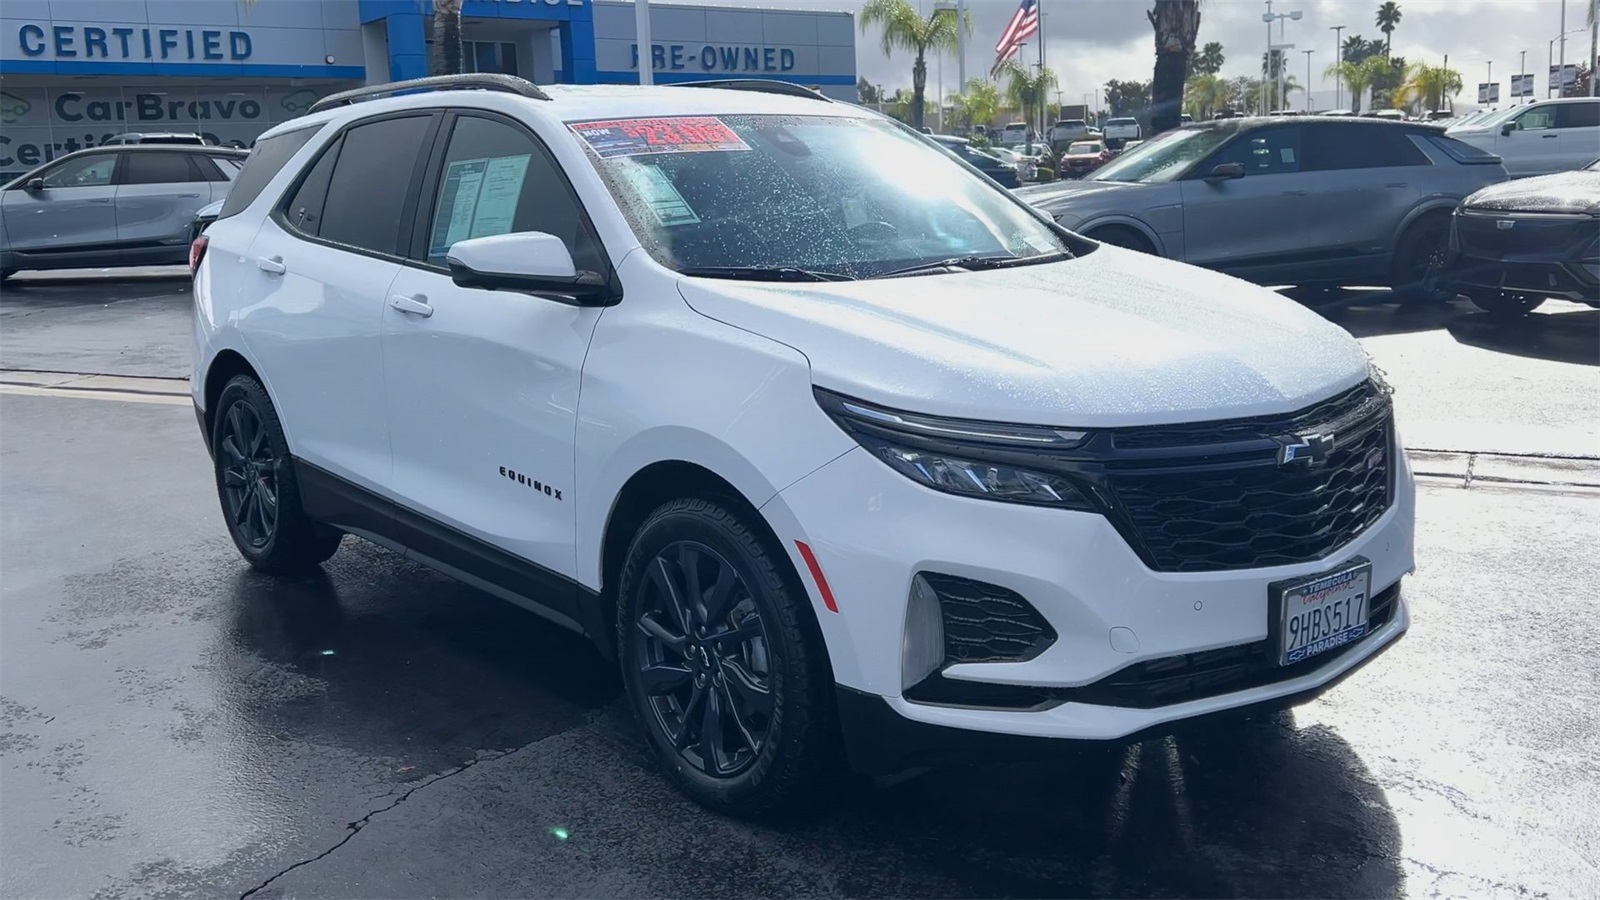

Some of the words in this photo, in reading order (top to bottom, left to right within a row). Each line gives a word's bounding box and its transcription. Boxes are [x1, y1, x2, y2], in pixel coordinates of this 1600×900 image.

[19, 24, 252, 61] CERTIFIED
[55, 93, 261, 122] CarBravo
[582, 128, 612, 137] NOW
[499, 465, 563, 501] EQUINOX
[1309, 572, 1353, 594] TEMECULA
[1288, 592, 1365, 651] 9HBS517
[1306, 632, 1348, 656] PARADISE
